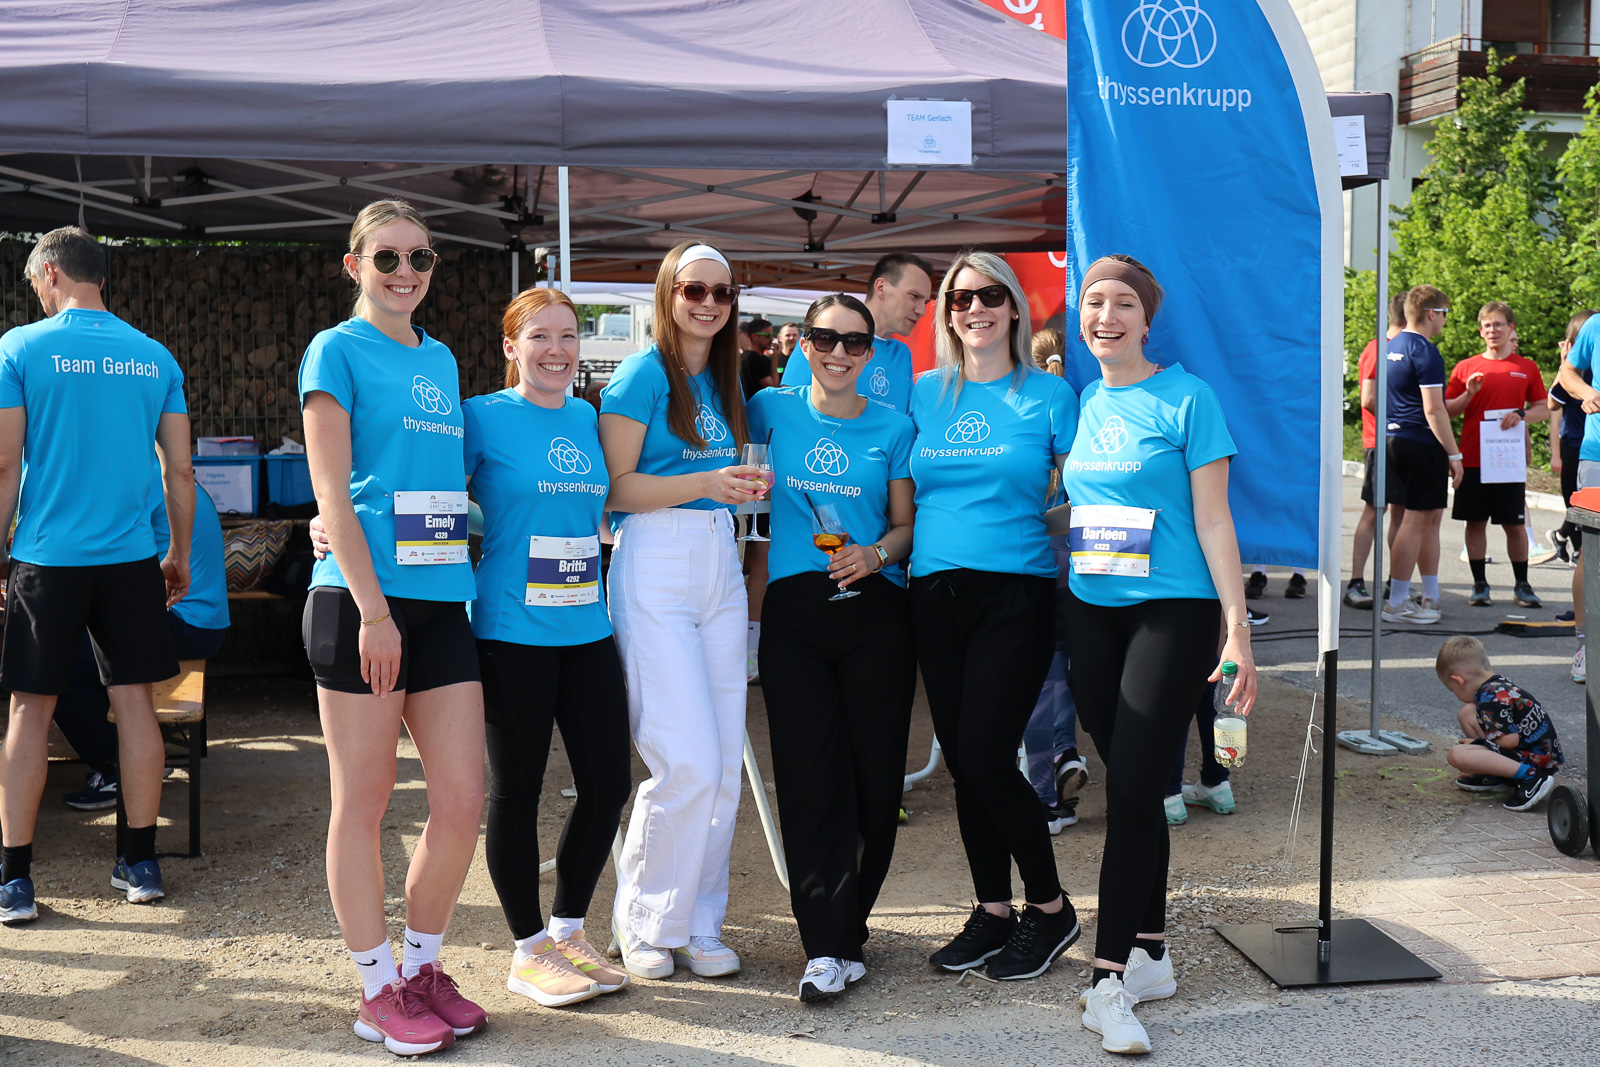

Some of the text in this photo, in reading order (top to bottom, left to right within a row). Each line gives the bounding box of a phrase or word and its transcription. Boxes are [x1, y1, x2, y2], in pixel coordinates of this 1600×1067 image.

[1097, 75, 1252, 112] thyssenkrupp
[927, 114, 952, 122] Gerlach
[51, 355, 159, 379] Team Gerlach
[682, 446, 739, 461] thyssenkrup
[919, 446, 1004, 460] thyssenkrupp
[1069, 459, 1142, 474] thyssenkrupp
[537, 480, 607, 497] thyssenkrupp
[786, 475, 862, 498] thyssenkrupp
[425, 515, 455, 531] Emely
[434, 531, 448, 540] 4320
[1082, 527, 1127, 541] Darleen
[558, 560, 587, 573] Britta
[565, 575, 580, 583] 4292
[1523, 720, 1538, 736] GO
